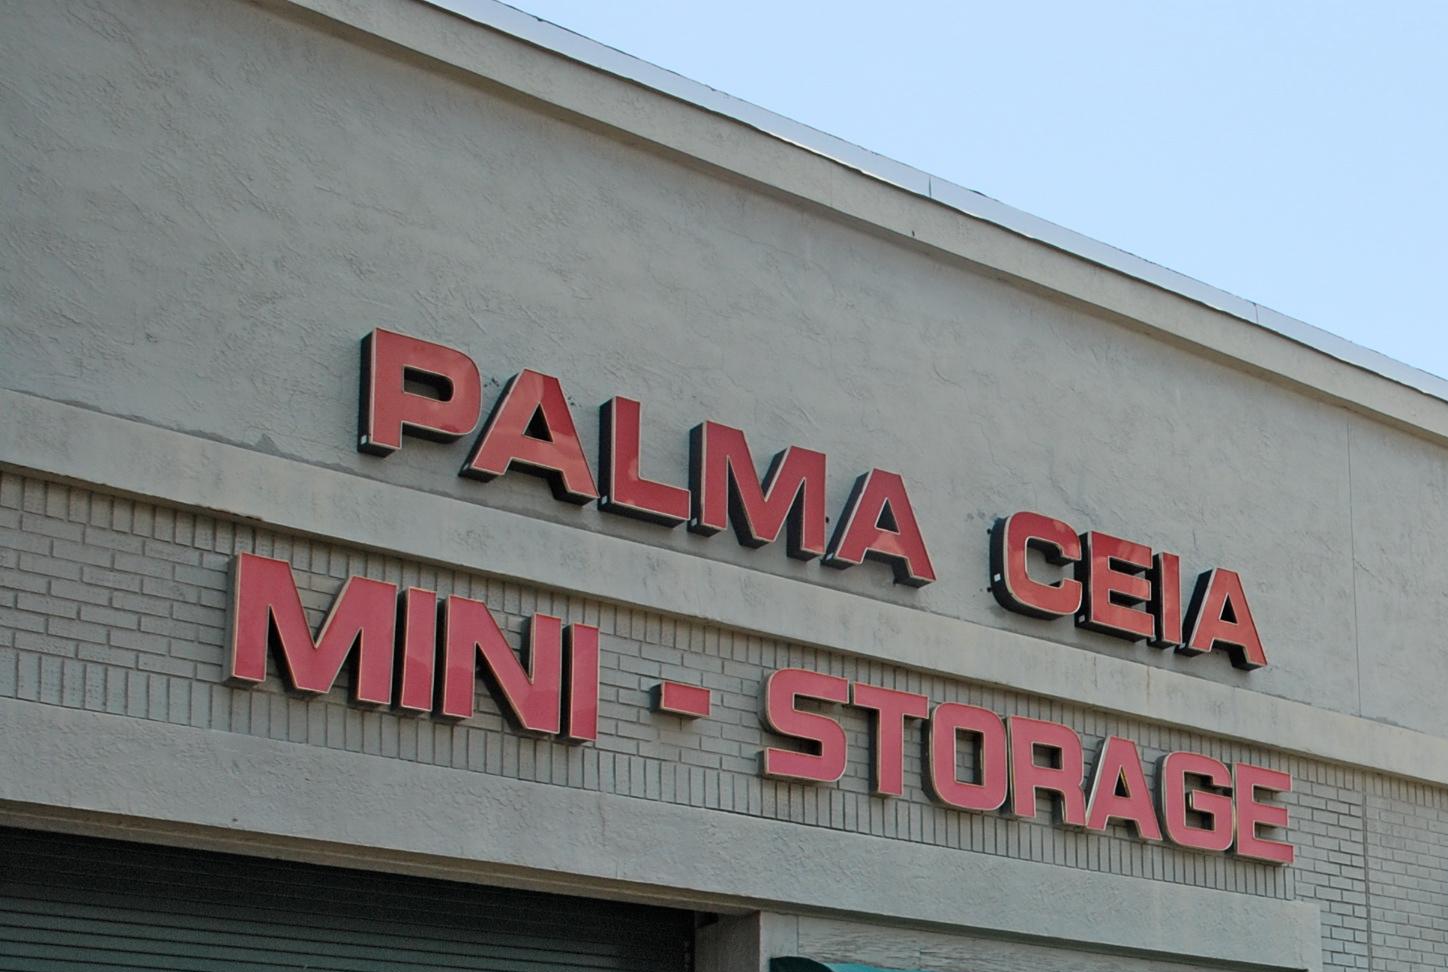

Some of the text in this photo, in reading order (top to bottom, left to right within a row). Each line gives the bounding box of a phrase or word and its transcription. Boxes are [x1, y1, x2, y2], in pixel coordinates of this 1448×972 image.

[358, 327, 1268, 670] PALMA CEIA
[226, 552, 599, 742] MINI
[761, 667, 1295, 866] STORAGE
